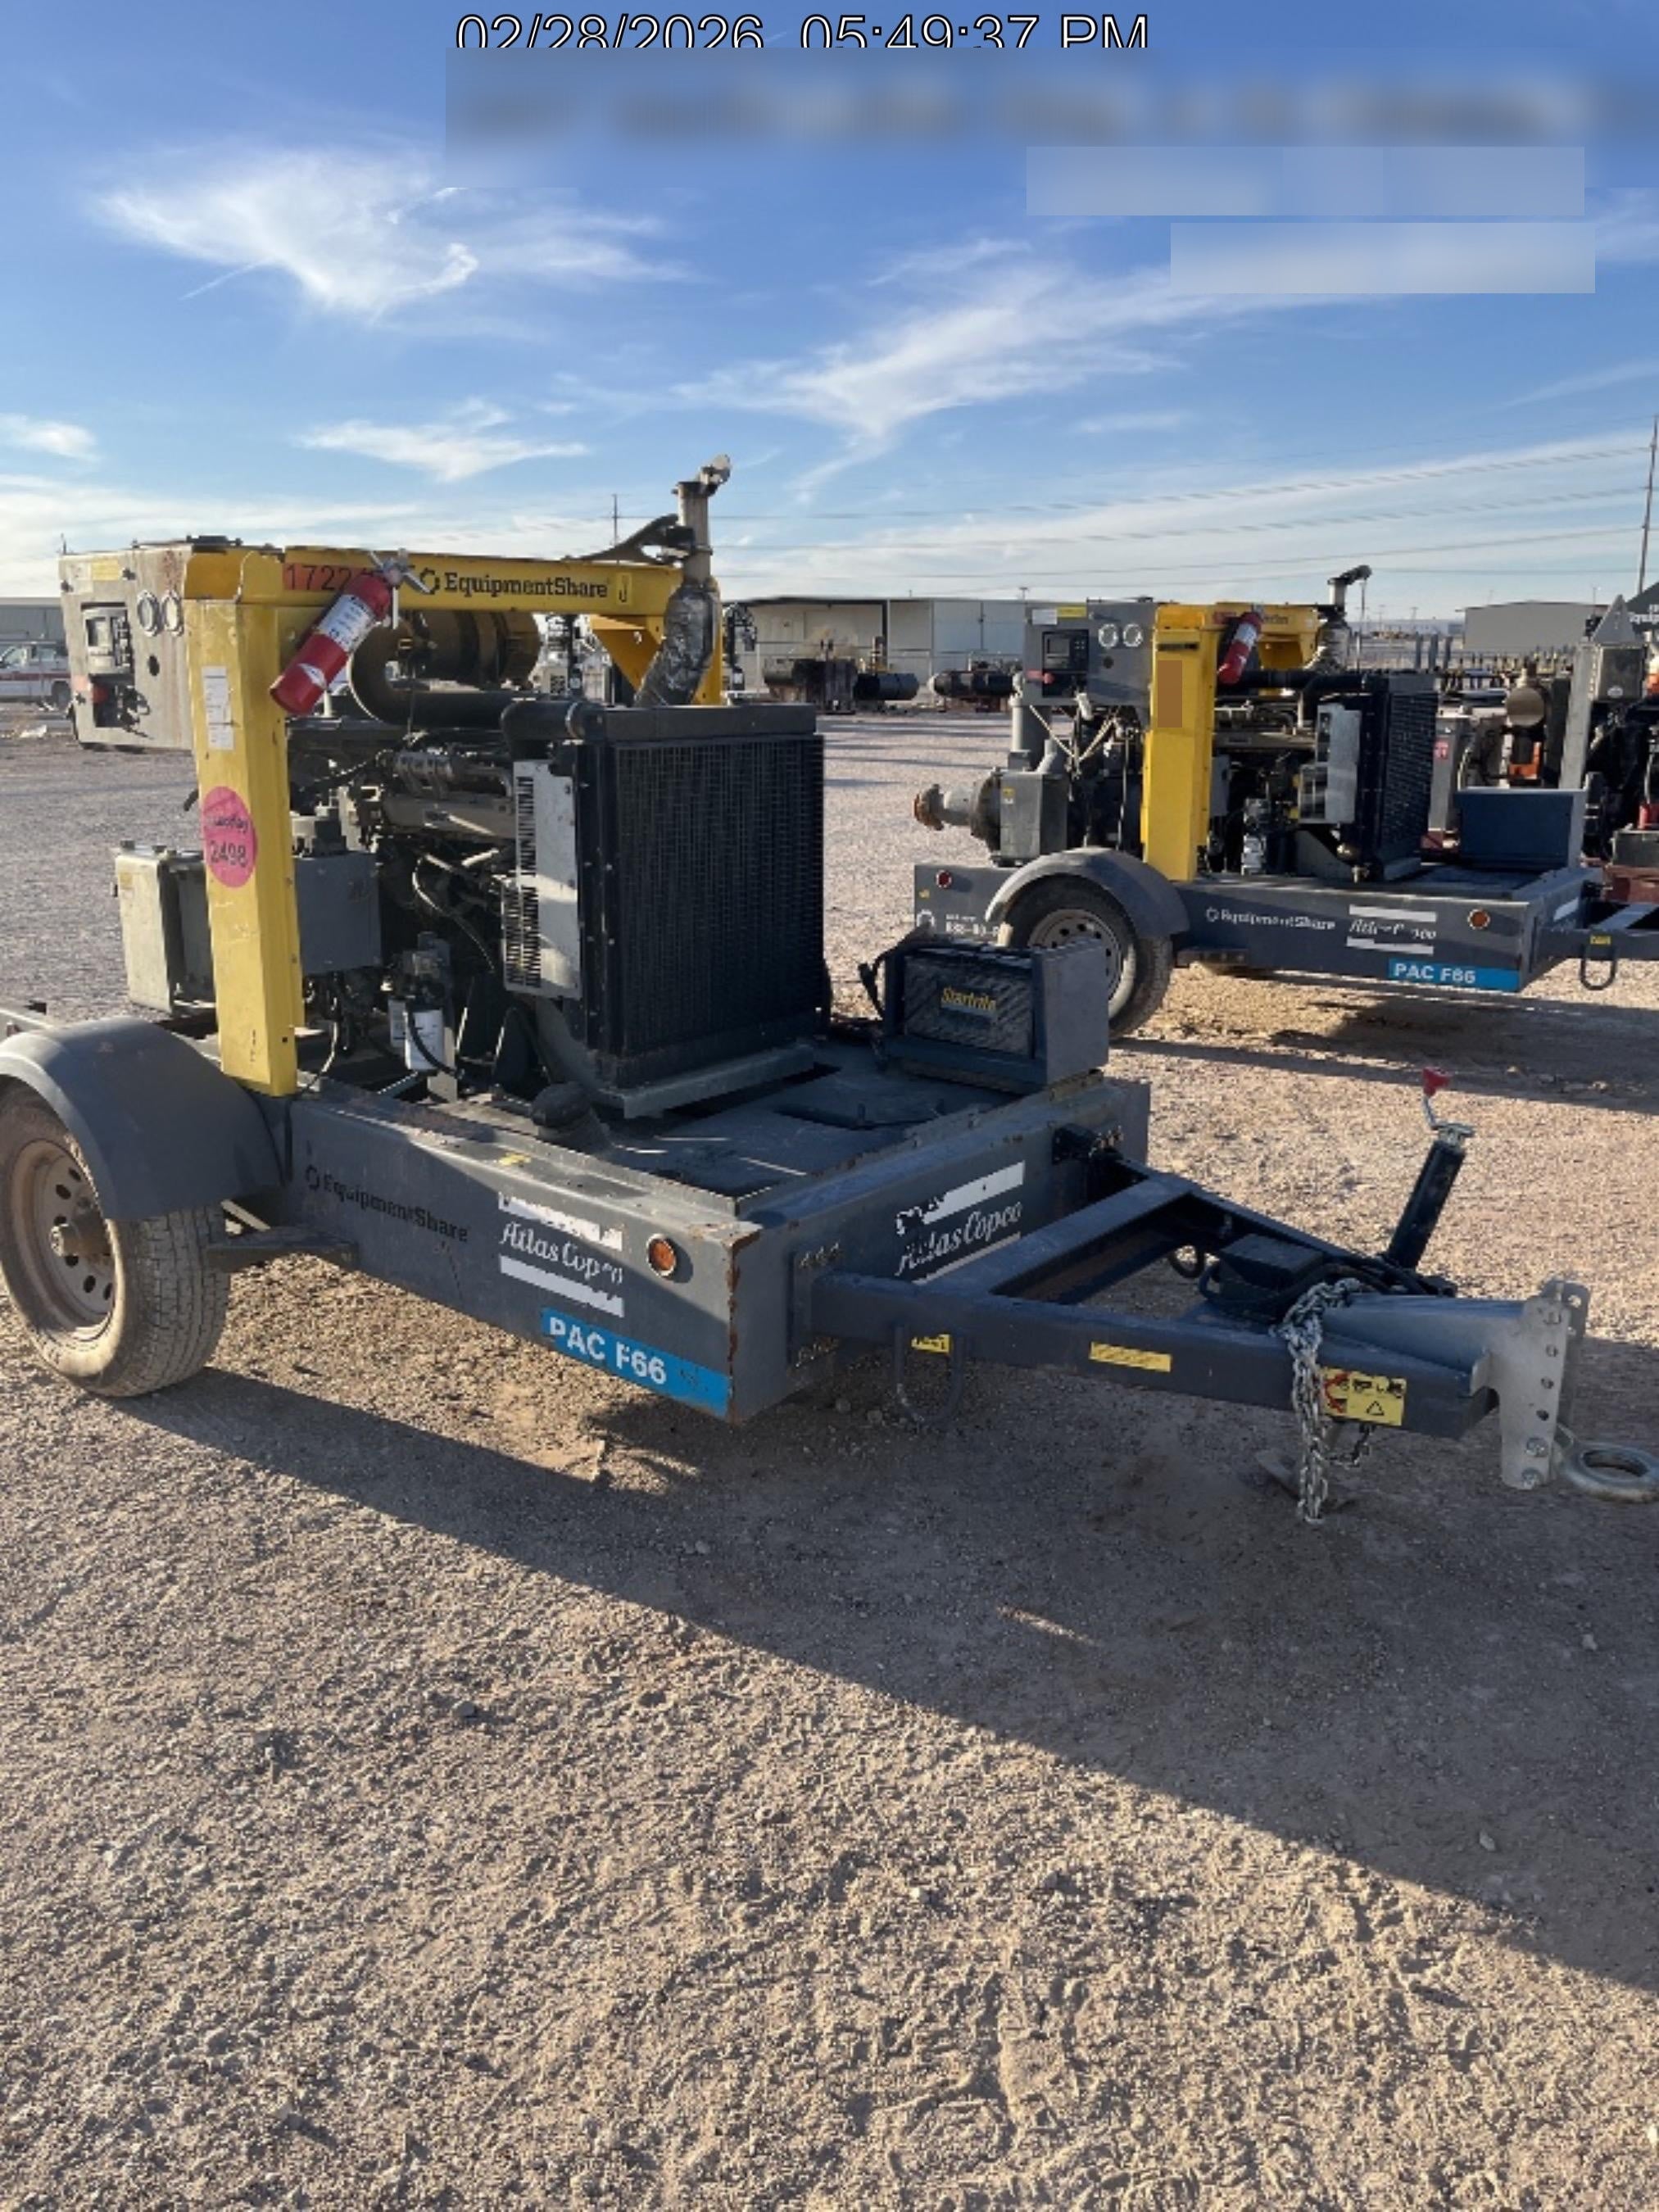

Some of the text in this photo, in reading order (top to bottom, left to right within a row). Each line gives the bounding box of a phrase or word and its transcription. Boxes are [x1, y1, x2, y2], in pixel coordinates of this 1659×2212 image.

[444, 572, 608, 598] EquipmentShare
[1394, 963, 1476, 984] PAC F66
[324, 1173, 469, 1243] EquipmentShare
[499, 1221, 559, 1262] Atlas
[550, 1317, 667, 1385] PAC F66
